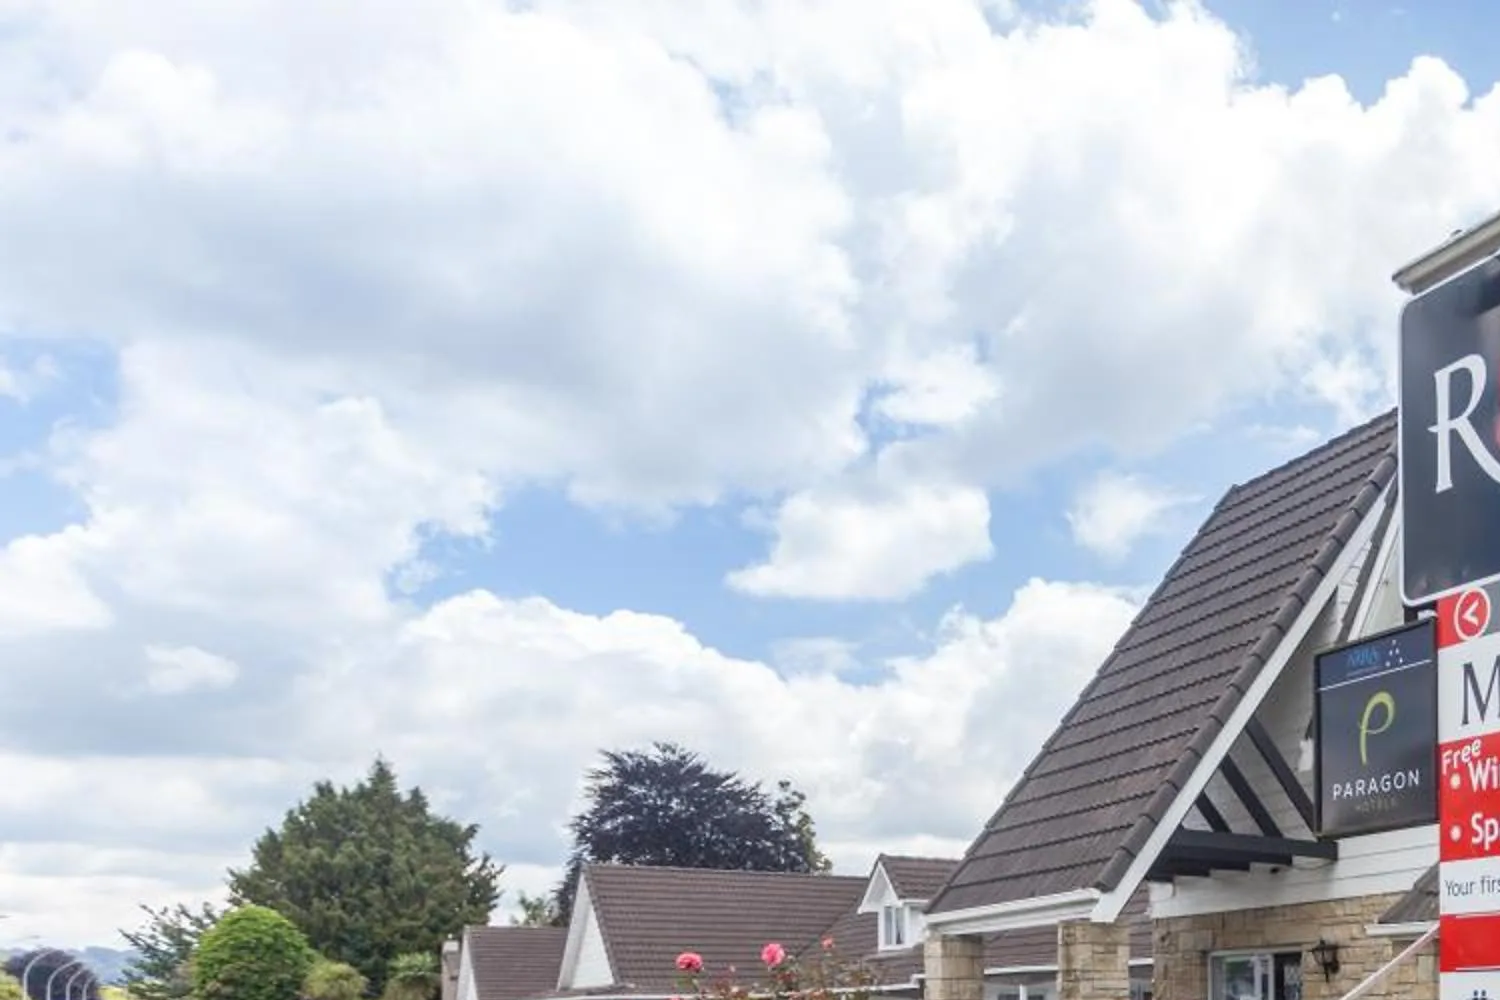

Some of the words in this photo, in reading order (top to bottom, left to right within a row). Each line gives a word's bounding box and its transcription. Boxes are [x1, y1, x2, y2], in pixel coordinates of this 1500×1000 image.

[1441, 738, 1481, 775] Free
[1333, 769, 1420, 800] PARAGON
[1445, 879, 1473, 897] Your
